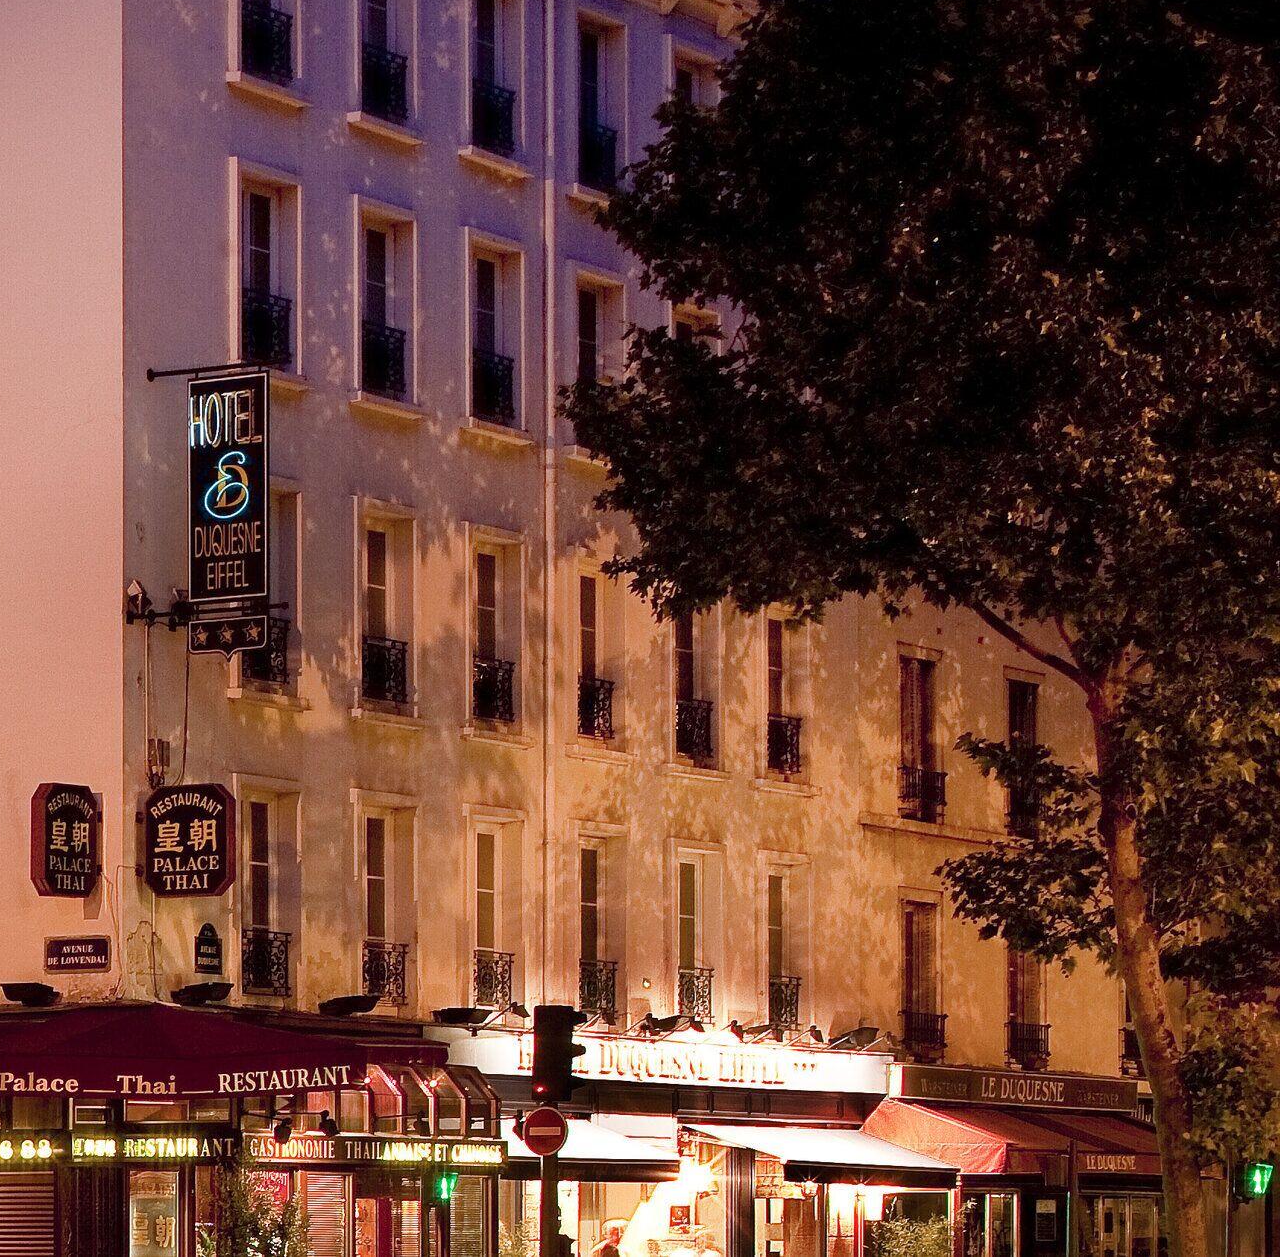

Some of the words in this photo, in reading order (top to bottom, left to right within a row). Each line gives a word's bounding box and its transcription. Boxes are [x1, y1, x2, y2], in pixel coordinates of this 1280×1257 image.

[190, 389, 261, 449] HOTEL
[194, 521, 261, 558] DUQUESNE
[207, 560, 249, 590] EIFFEL
[47, 792, 94, 819] RESTAURANT
[150, 793, 223, 819] RESTAURANT
[50, 819, 90, 855] 皇朝
[154, 819, 217, 853] 皇朝
[49, 855, 92, 873] PALACE
[153, 855, 220, 873] PALACE
[55, 873, 85, 891] THAI
[162, 874, 208, 890] THAI
[62, 945, 94, 954] AVENUE
[116, 1075, 178, 1094] Thai
[218, 1065, 351, 1093] RESTAURANT
[981, 1076, 997, 1098] LE
[1001, 1078, 1065, 1103] DUQUESNE
[125, 1139, 234, 1157] RESTAURANT
[250, 1138, 336, 1159] GASTRONOMIE
[434, 1143, 449, 1162] ET
[1086, 1155, 1097, 1170] LE
